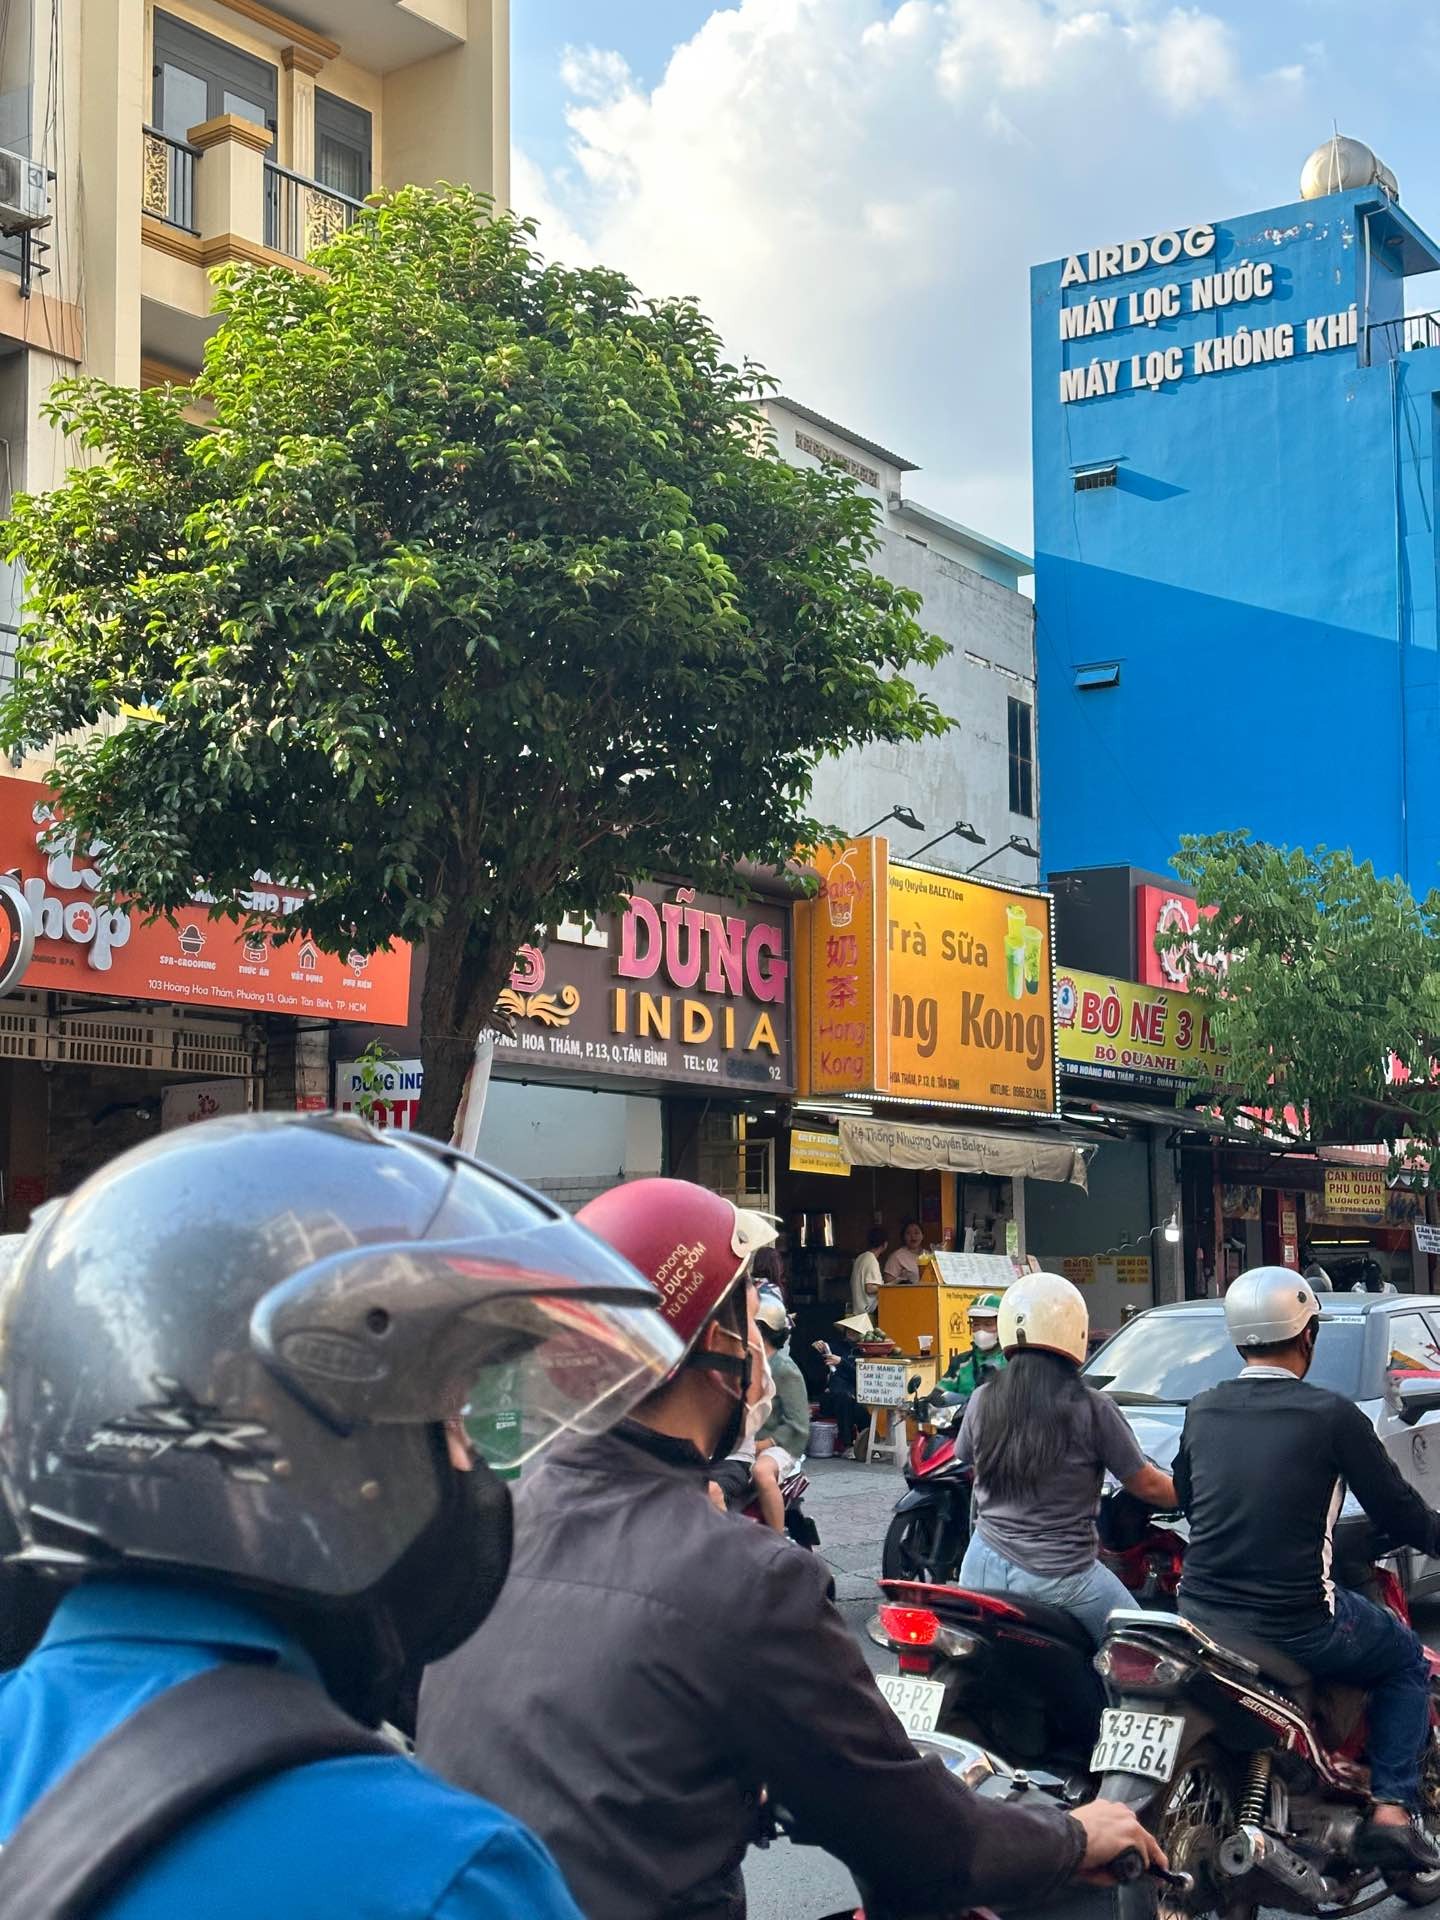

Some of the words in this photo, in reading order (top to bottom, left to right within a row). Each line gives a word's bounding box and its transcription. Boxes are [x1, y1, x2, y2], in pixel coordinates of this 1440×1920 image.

[1059, 224, 1216, 289] AIRDOG
[1059, 293, 1119, 341] MÁY
[1128, 283, 1181, 328] LỌC
[1191, 258, 1274, 312] NƯỚC
[1059, 357, 1121, 404] MÁY
[1131, 347, 1184, 391] LỌC
[1194, 325, 1294, 375] KHÔNG
[1306, 302, 1358, 353] KHÍ
[617, 886, 788, 1004] DŨNG
[888, 920, 927, 957] Trà
[941, 929, 989, 968] Sữa
[148, 979, 163, 990] 103
[613, 987, 781, 1055] INDIA
[960, 990, 1045, 1071] Kong
[1080, 985, 1122, 1038] BÒ
[1130, 995, 1169, 1046] NÉ
[1175, 1008, 1193, 1049] 3
[522, 1034, 545, 1051] HOA
[549, 1035, 583, 1058] THÁM,
[586, 1042, 610, 1062] P.13,
[644, 1046, 667, 1066] BÌNH
[683, 1054, 705, 1071] TEL:
[706, 1057, 719, 1073] 02
[1095, 1043, 1118, 1062] BÒ
[1120, 1049, 1177, 1072] QUANH
[655, 1243, 690, 1284] phong
[1239, 1695, 1290, 1728] SIRIUS
